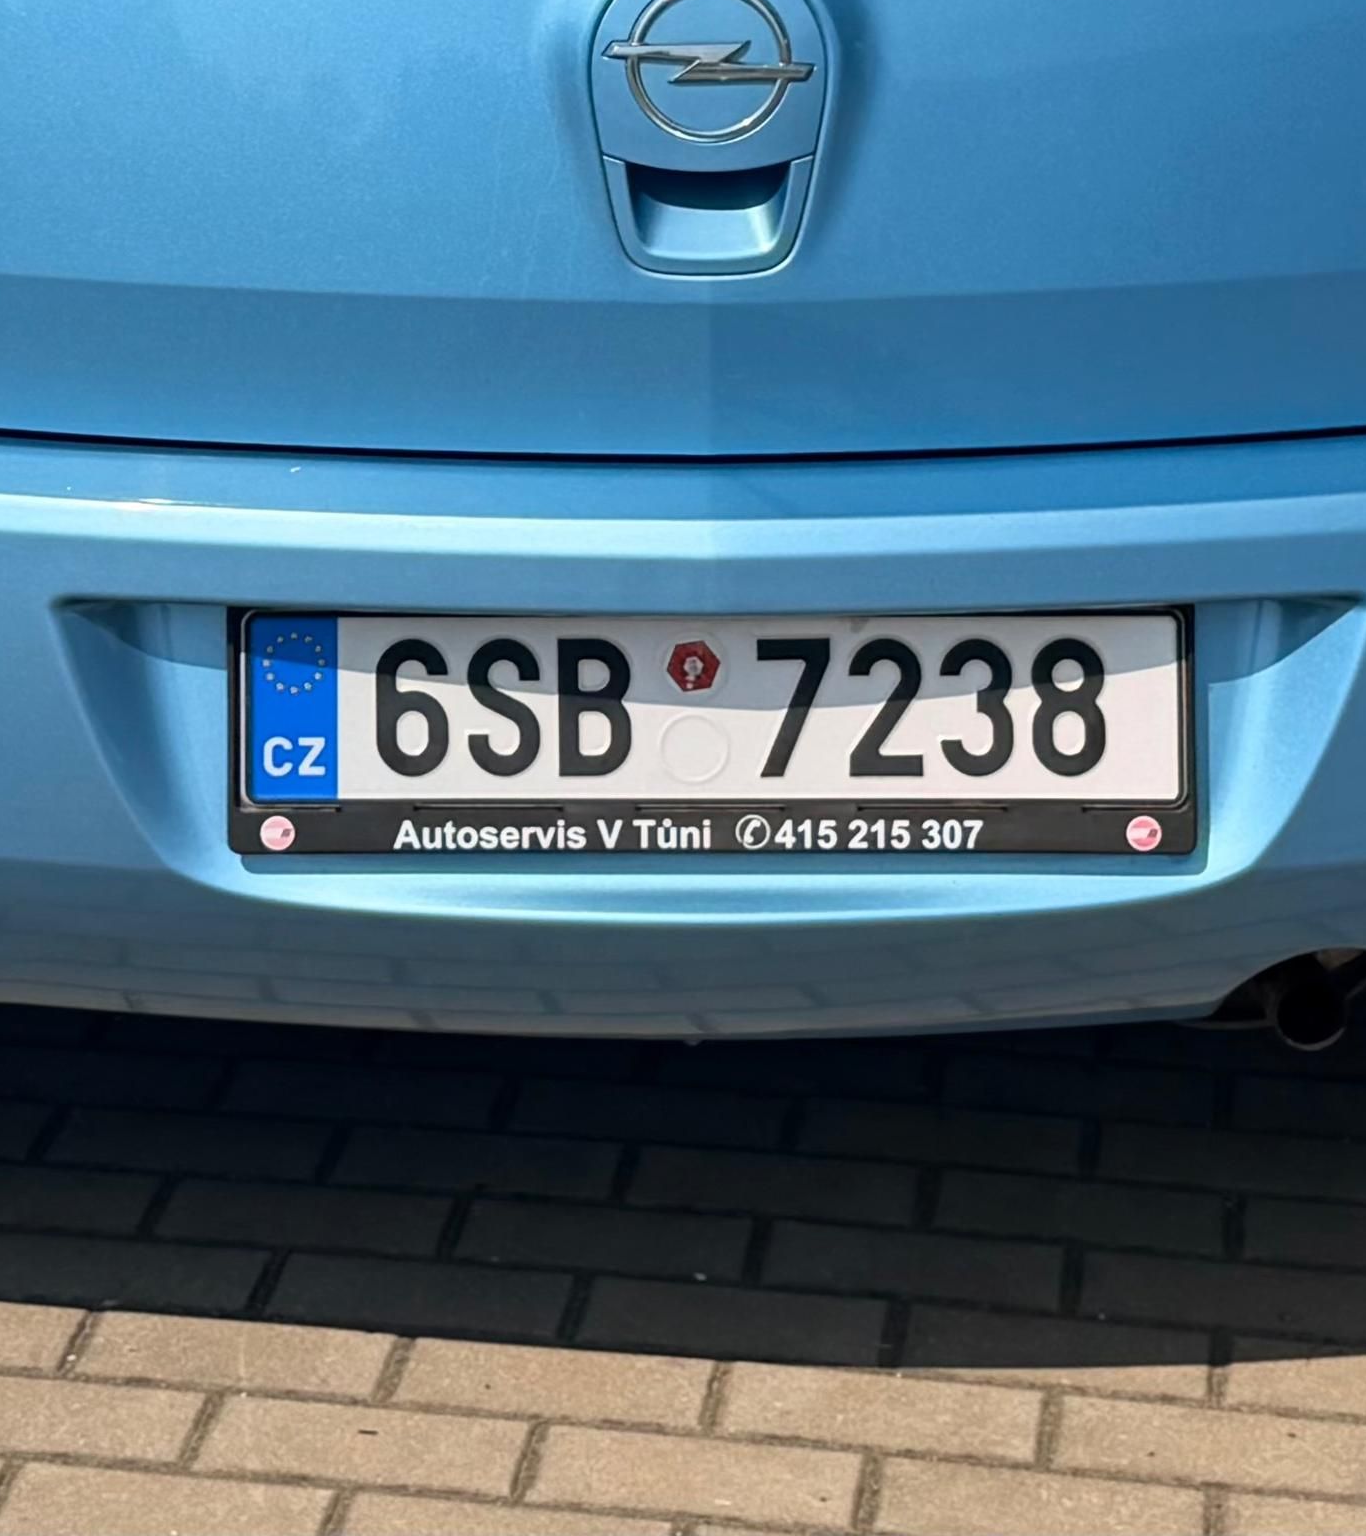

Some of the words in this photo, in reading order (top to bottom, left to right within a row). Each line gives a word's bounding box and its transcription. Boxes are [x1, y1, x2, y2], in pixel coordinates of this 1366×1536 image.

[375, 637, 632, 777] 6SB
[756, 637, 1107, 777] 7238
[262, 736, 326, 777] CZ
[393, 819, 587, 850] Autoservis
[596, 820, 624, 849] V
[633, 818, 712, 850] Tůni
[774, 819, 837, 850] 415
[847, 819, 911, 850] 215
[921, 819, 985, 850] 307
